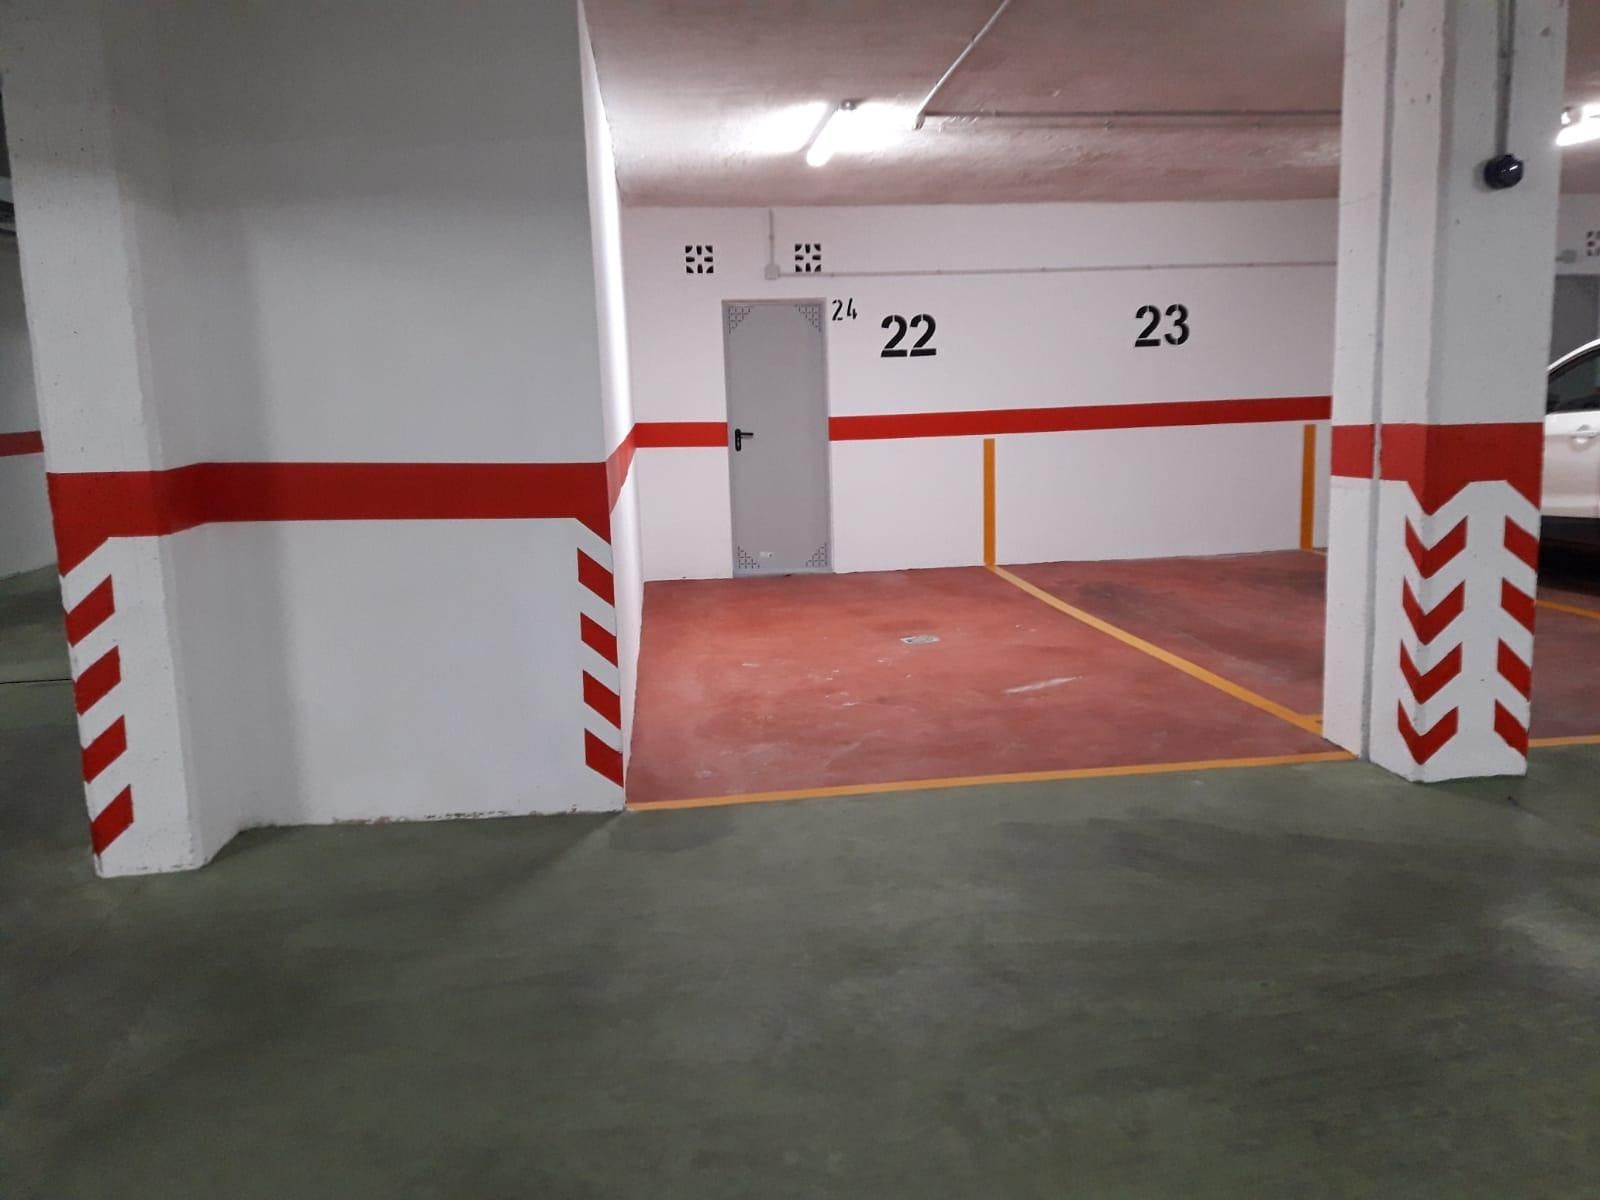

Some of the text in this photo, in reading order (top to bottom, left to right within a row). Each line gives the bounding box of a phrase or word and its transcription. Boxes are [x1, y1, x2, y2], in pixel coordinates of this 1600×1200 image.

[832, 297, 858, 321] 24
[1134, 303, 1190, 348] 23
[880, 313, 937, 358] 22
